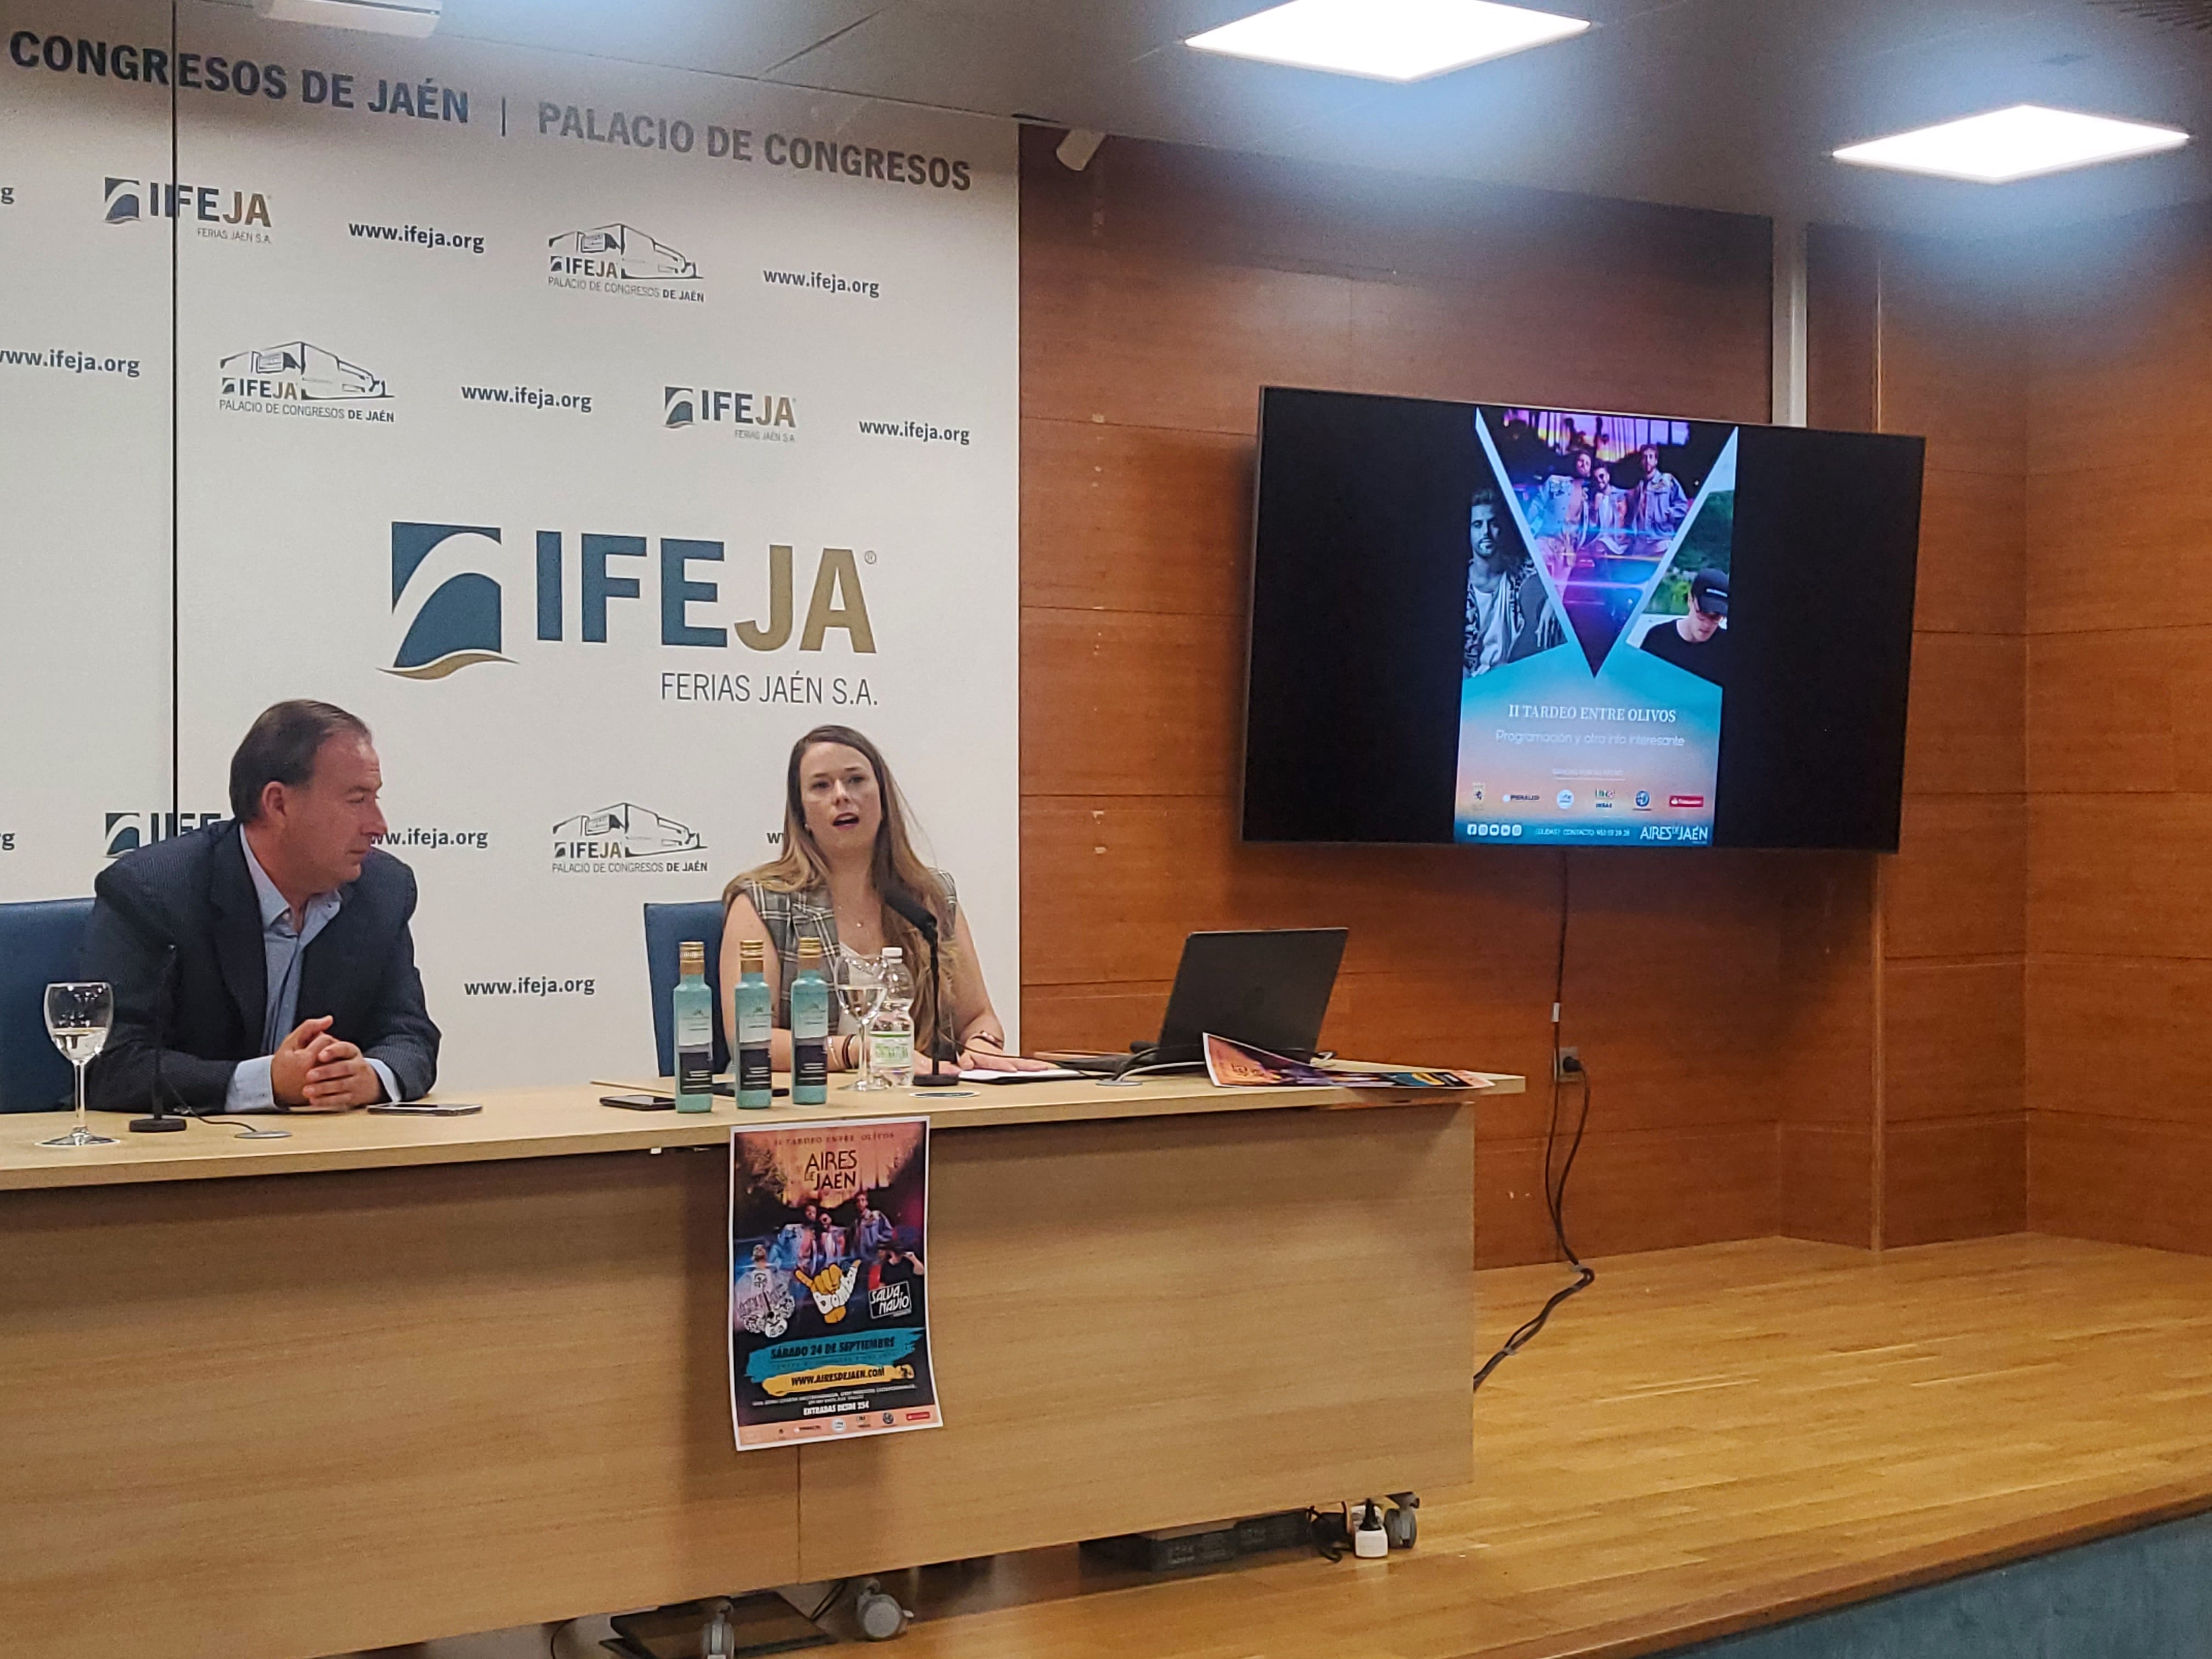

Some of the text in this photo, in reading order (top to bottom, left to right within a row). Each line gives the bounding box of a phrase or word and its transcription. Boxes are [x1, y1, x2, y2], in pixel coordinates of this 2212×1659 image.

[9, 31, 469, 123] CONGRESOS DE JAÉN
[538, 101, 971, 191] PALACIO DE CONGRESOS
[150, 182, 271, 228] IFEJA
[198, 228, 228, 239] FERIAS
[349, 222, 485, 253] www.ifeja.org
[566, 257, 617, 279] IFEJA
[549, 276, 704, 302] PALACIO DE CONGRESOS DE JAÉN
[763, 268, 879, 298] www.ifeja.org
[240, 379, 297, 400] IFEJA
[461, 385, 592, 413] www.ifeja.org
[219, 399, 394, 422] PALACIO DE CONGRESOS DE JAÉN
[702, 390, 796, 427] IFEJA
[859, 419, 969, 444] www.ifeja.org
[662, 670, 878, 706] FERIAS JAÉN S.A.
[1509, 704, 1677, 723] II TARDEO ENTRE OLIVOS
[1496, 729, 1572, 744] Programación
[1575, 734, 1581, 744] y
[1629, 734, 1685, 747] interesante
[371, 828, 488, 848] ww.ifeja.org
[1640, 826, 1672, 840] AIRES
[1677, 825, 1708, 840] JAÉN
[570, 842, 621, 859] IFEJA
[552, 860, 708, 873] PALACIO DE CONGRESOS DE JAÉN
[465, 976, 595, 996] www.ifeja.org
[805, 1150, 857, 1173] AIRES
[814, 1171, 856, 1190] JAÉN
[771, 1337, 895, 1359] SÁBADO 24 DE SEPTIEMBRE
[803, 1404, 836, 1416] ENTRADAS
